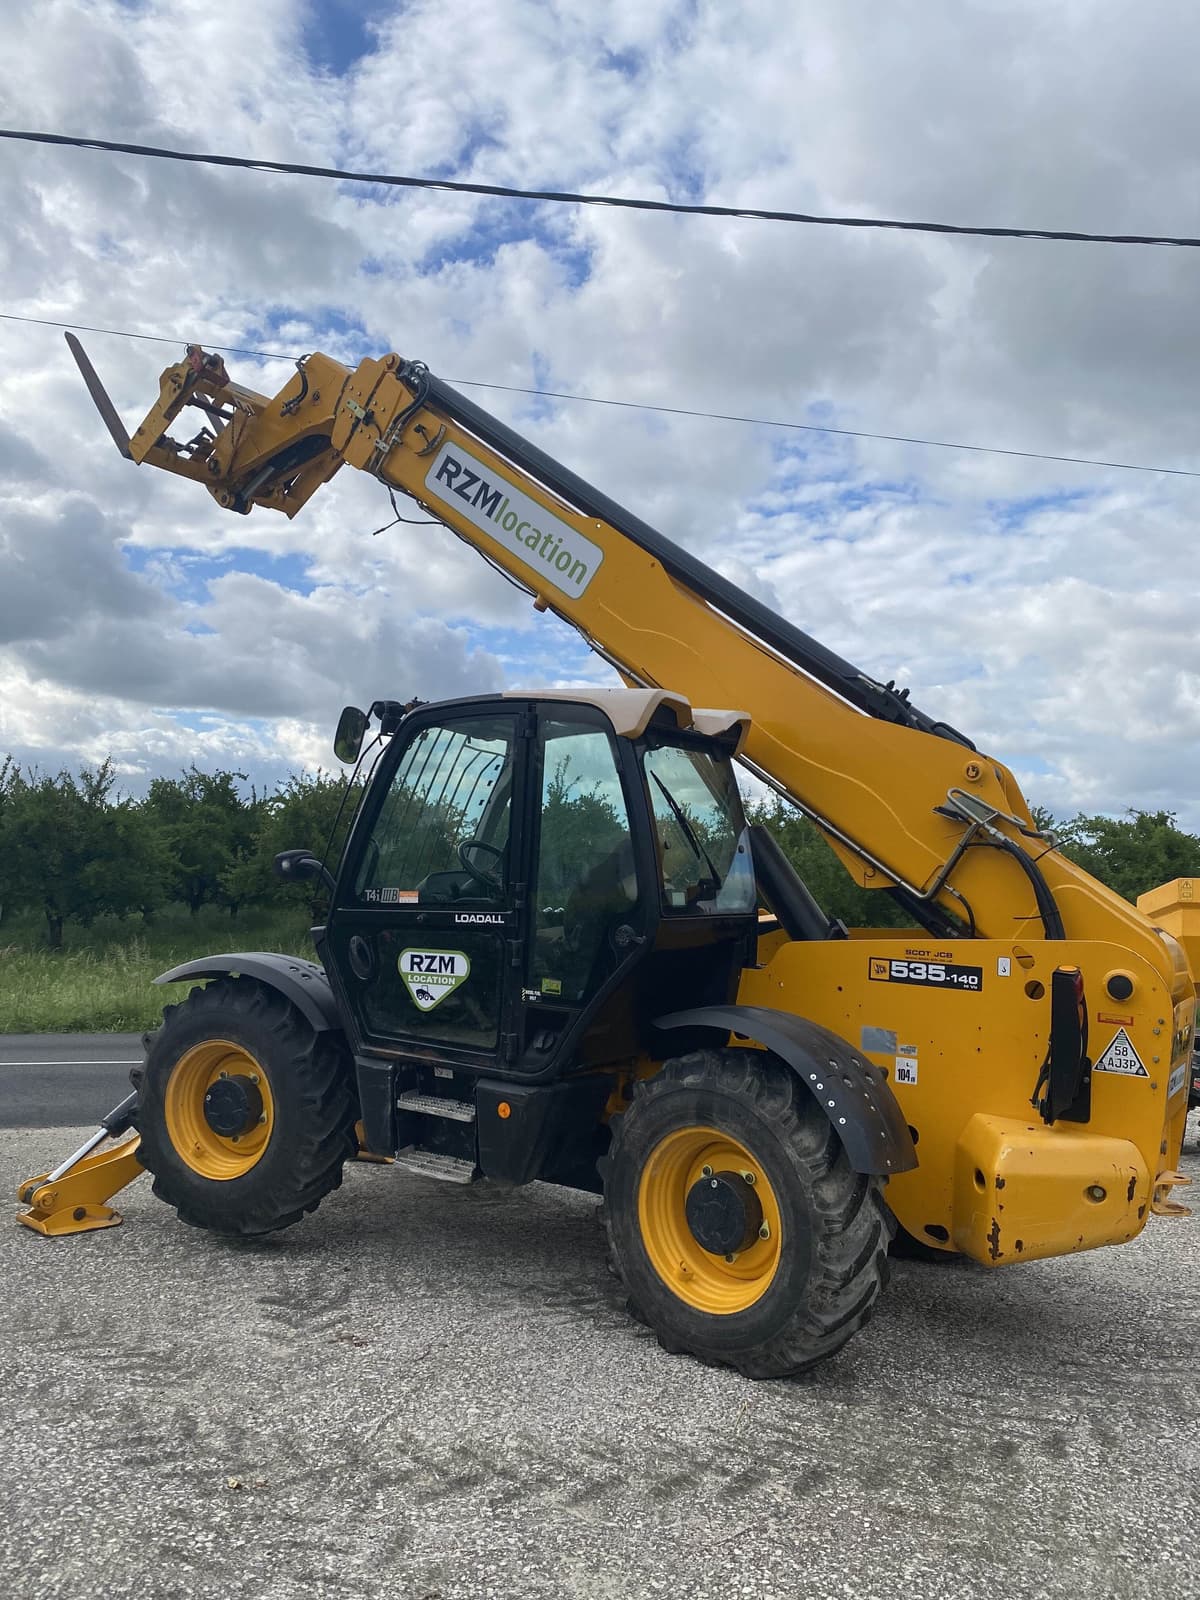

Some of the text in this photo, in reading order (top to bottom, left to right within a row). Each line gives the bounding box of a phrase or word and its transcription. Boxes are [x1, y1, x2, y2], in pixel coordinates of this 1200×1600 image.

[364, 889, 380, 901] T4i
[455, 914, 505, 923] LOADALL
[934, 951, 953, 959] JCB
[410, 954, 456, 974] RZM
[891, 960, 978, 985] 535-140
[408, 974, 456, 985] LOCATION
[1114, 1046, 1128, 1056] 58
[1107, 1057, 1136, 1069] AJ3P
[897, 1068, 911, 1082] 104
